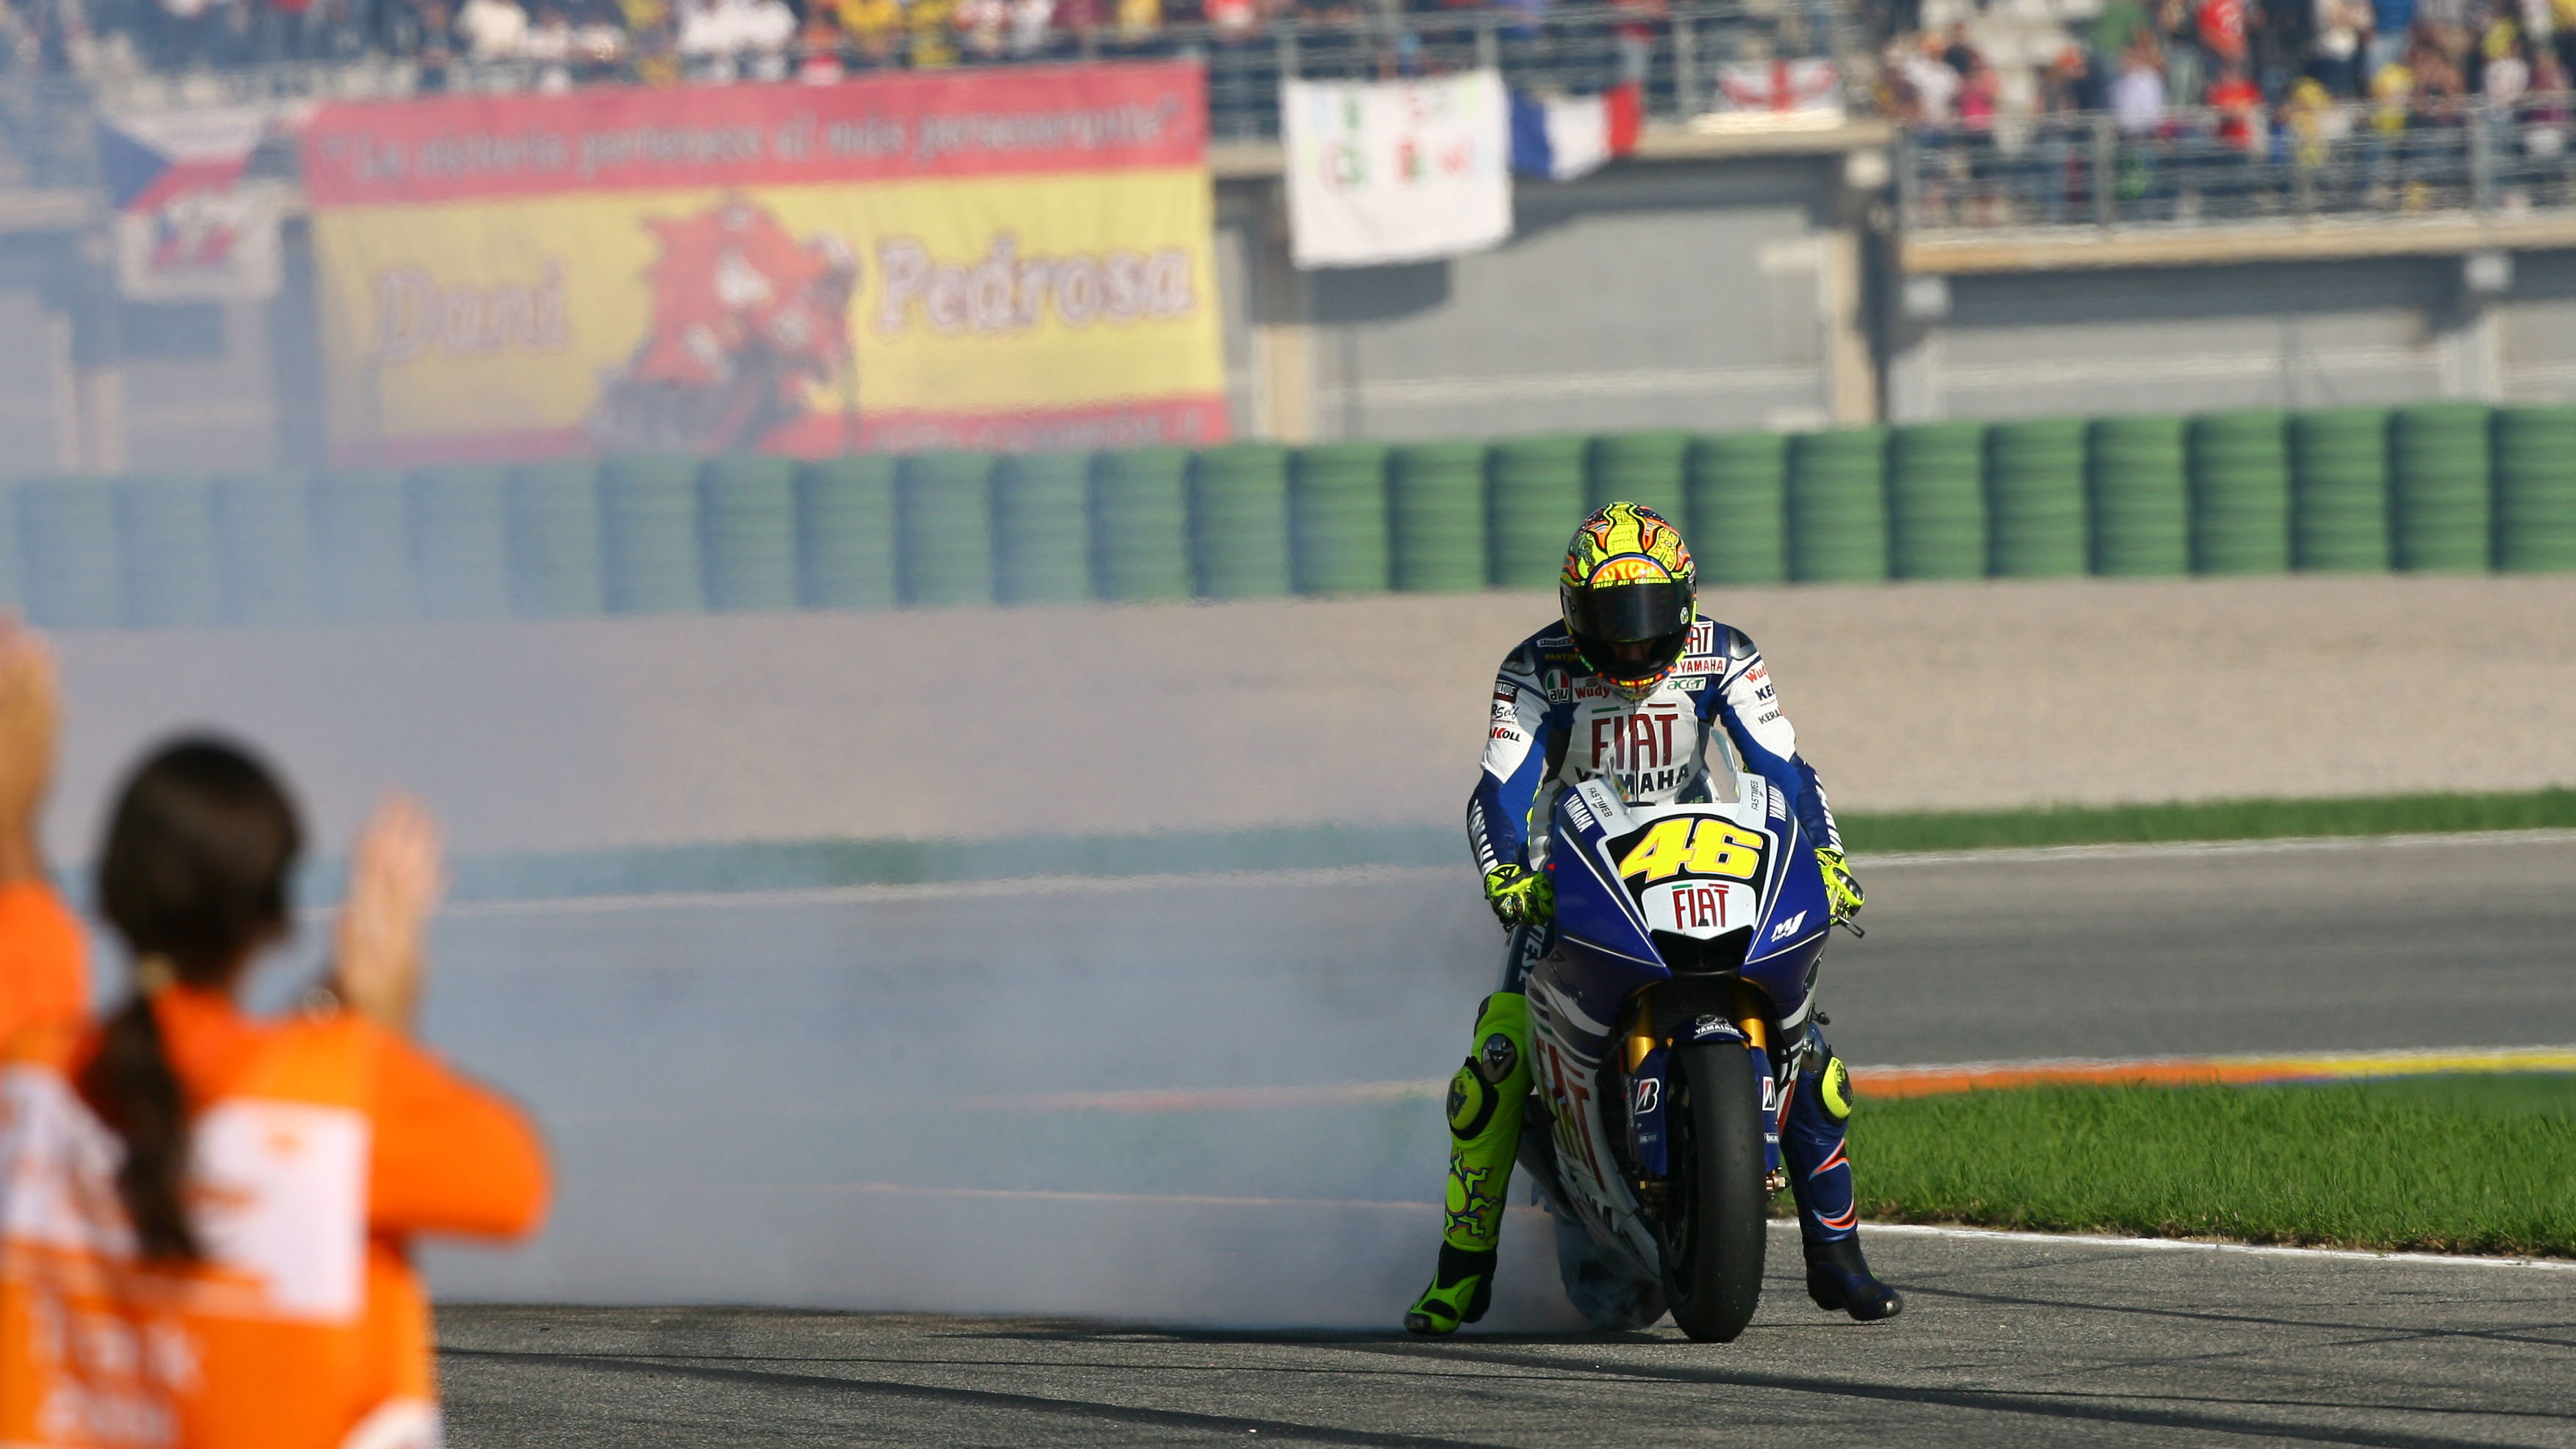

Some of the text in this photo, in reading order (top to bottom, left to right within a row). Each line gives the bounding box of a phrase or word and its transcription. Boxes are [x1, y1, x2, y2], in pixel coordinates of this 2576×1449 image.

[875, 228, 1197, 337] Pedrosa
[372, 257, 568, 363] Dani
[1667, 679, 1705, 690] acer
[1680, 659, 1724, 673] YAMAHA
[1575, 684, 1611, 699] Wudy
[1592, 713, 1678, 770] FIAT
[1563, 793, 1595, 833] YAMAHA
[1619, 817, 1764, 884] 46
[1672, 888, 1729, 929] FIAT
